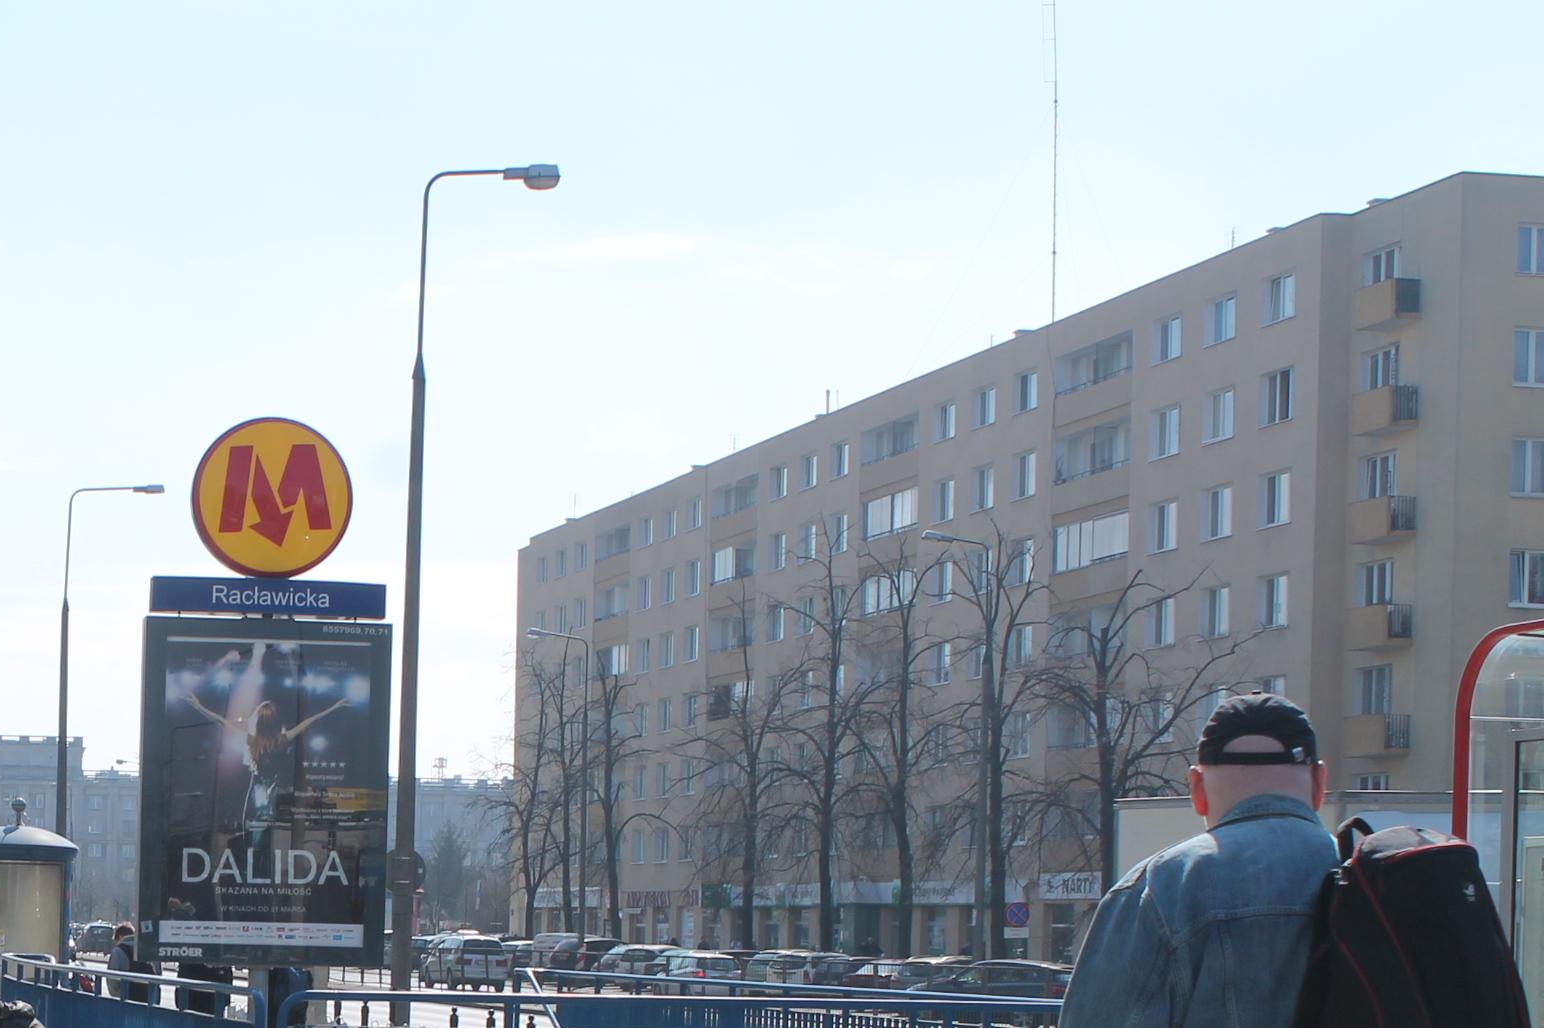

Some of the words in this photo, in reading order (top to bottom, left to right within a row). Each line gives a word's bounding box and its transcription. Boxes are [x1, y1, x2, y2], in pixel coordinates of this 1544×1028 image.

[212, 585, 330, 608] Racławicka
[181, 847, 349, 886] DALIDA
[216, 886, 259, 895] SKAZANA
[261, 887, 275, 895] NA
[1062, 878, 1093, 894] NARTY
[158, 946, 203, 957] STRÖER
